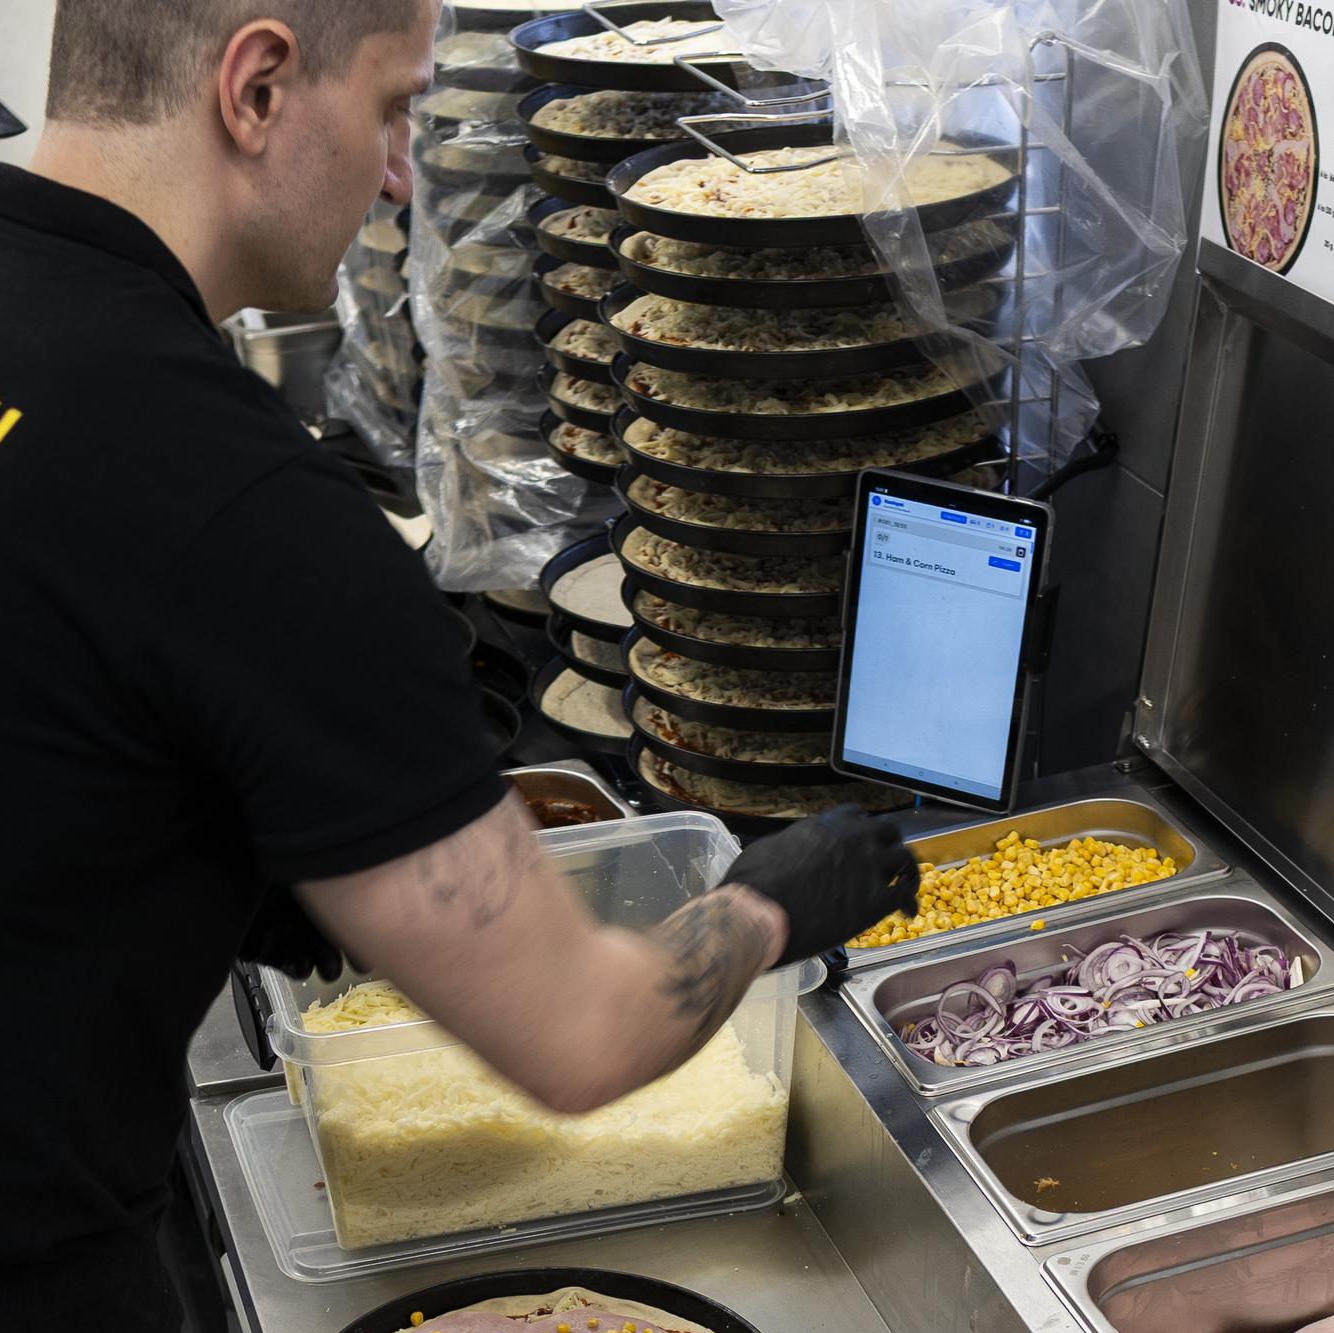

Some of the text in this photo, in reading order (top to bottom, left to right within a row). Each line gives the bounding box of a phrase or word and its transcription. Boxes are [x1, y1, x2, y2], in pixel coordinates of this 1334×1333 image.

[873, 550, 956, 577] 13. Ham & Corn Pizza
